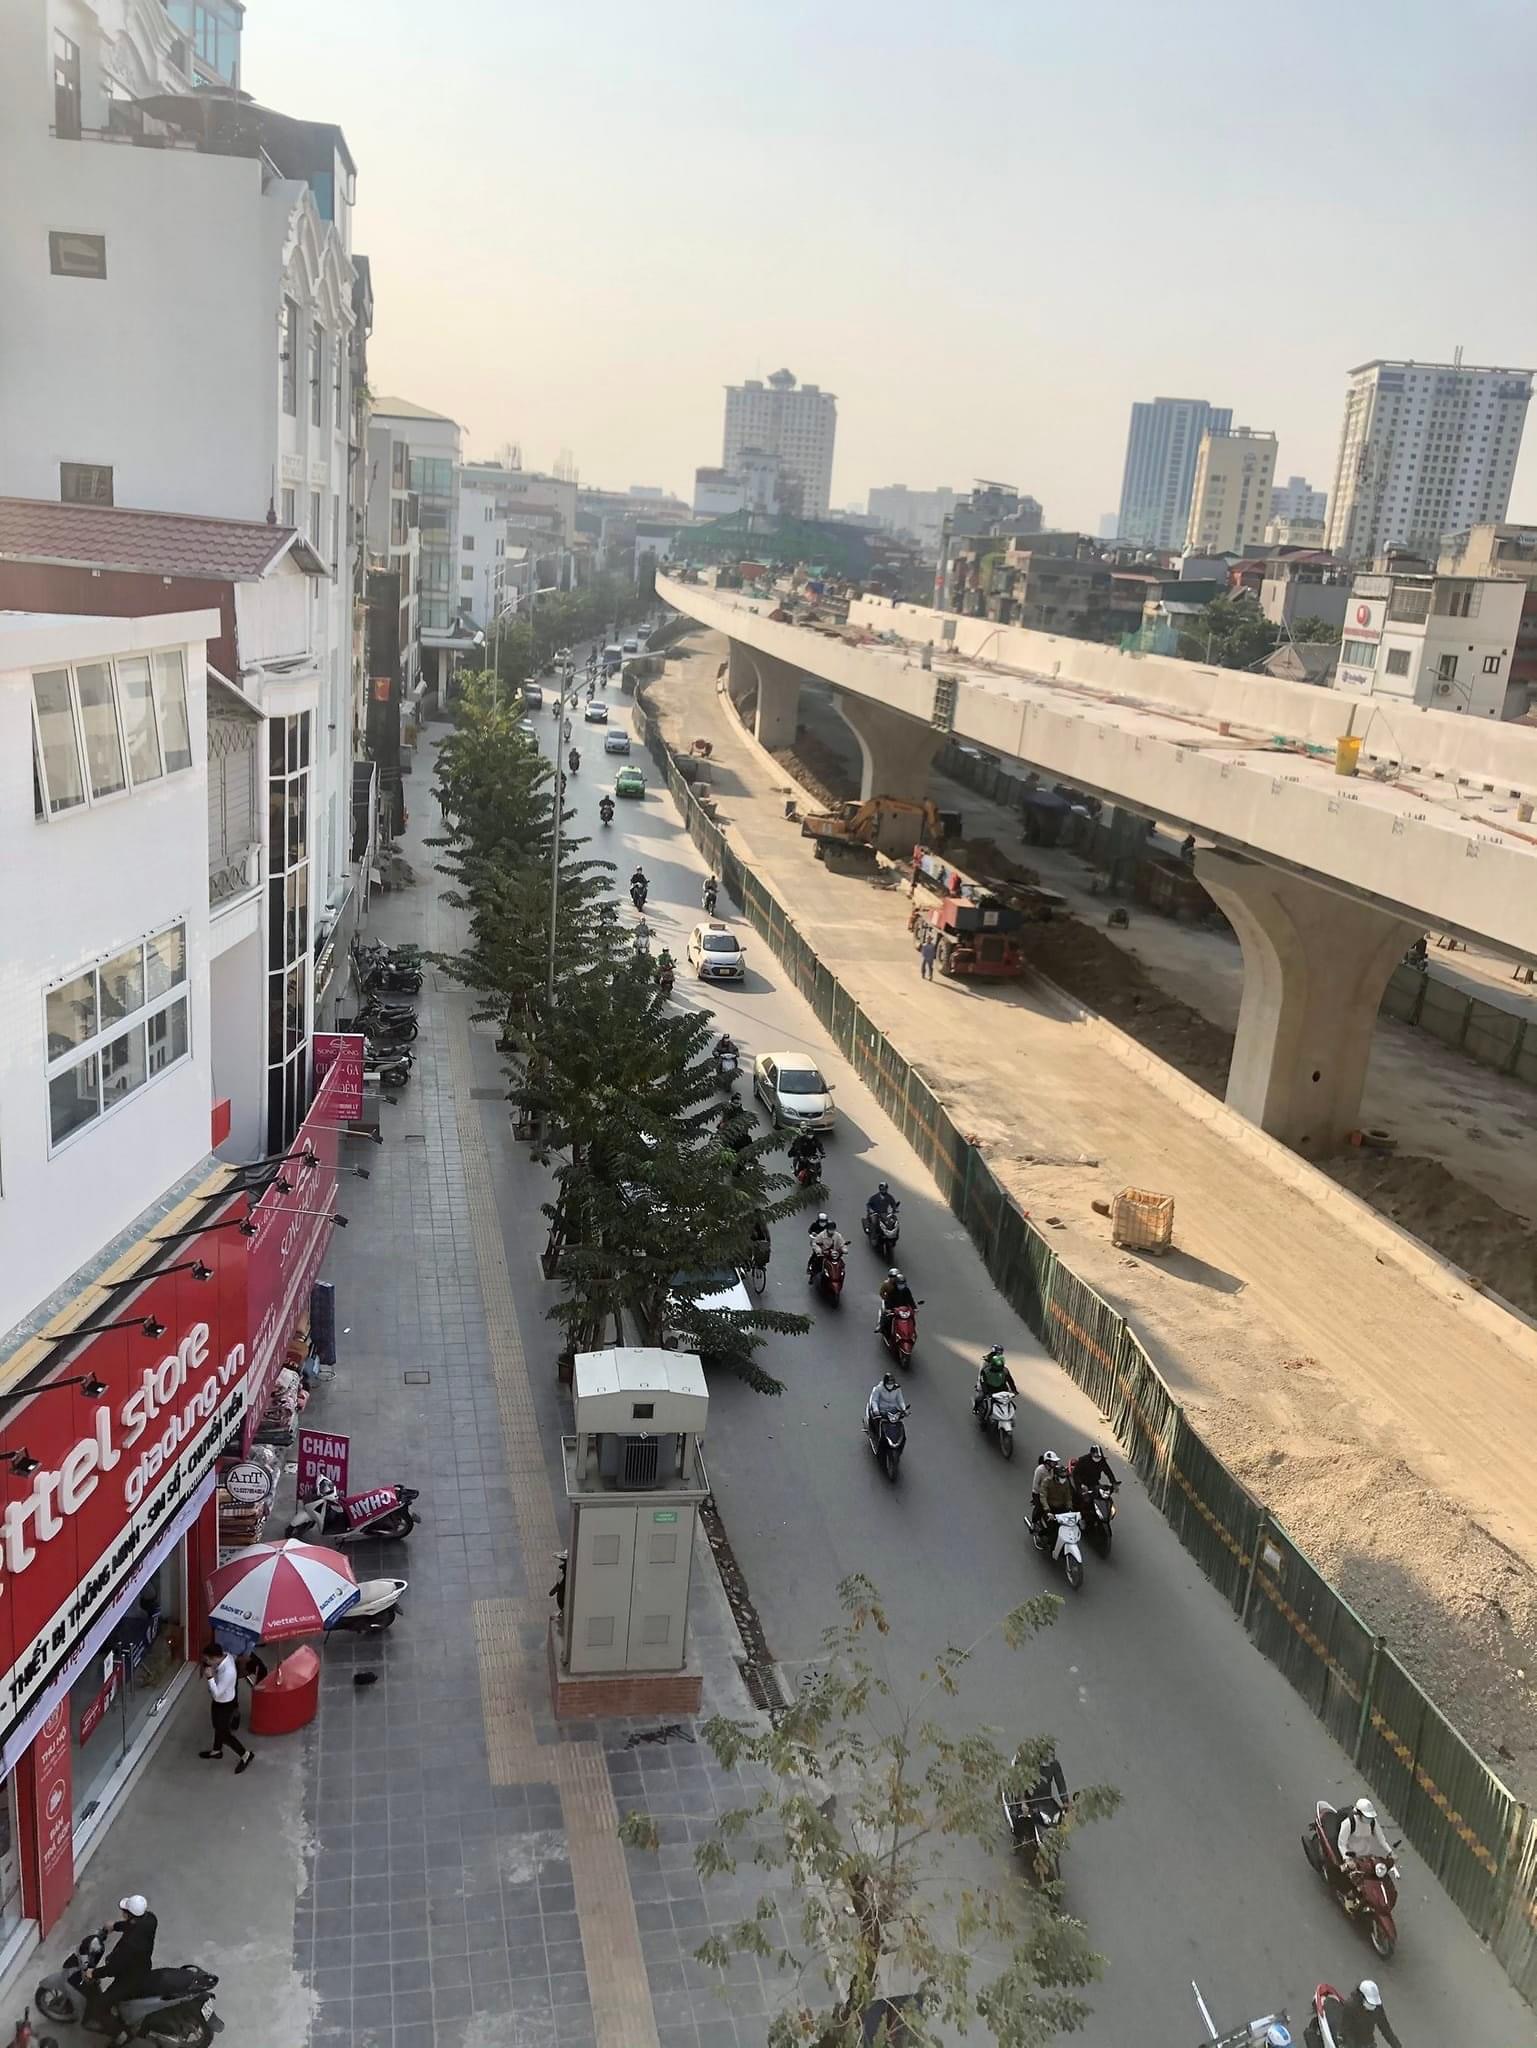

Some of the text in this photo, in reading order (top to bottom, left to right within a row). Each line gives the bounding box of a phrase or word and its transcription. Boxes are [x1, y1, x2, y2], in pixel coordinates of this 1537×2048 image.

[121, 1322, 209, 1449] store
[125, 1343, 244, 1512] giadung.vn
[302, 1436, 346, 1460] CHĂN
[349, 1490, 391, 1519] CHĂN
[8, 1639, 49, 1702] THIẾT
[51, 1620, 66, 1650] BỊ
[67, 1564, 110, 1627] THÔNG
[267, 1615, 298, 1628] viettel
